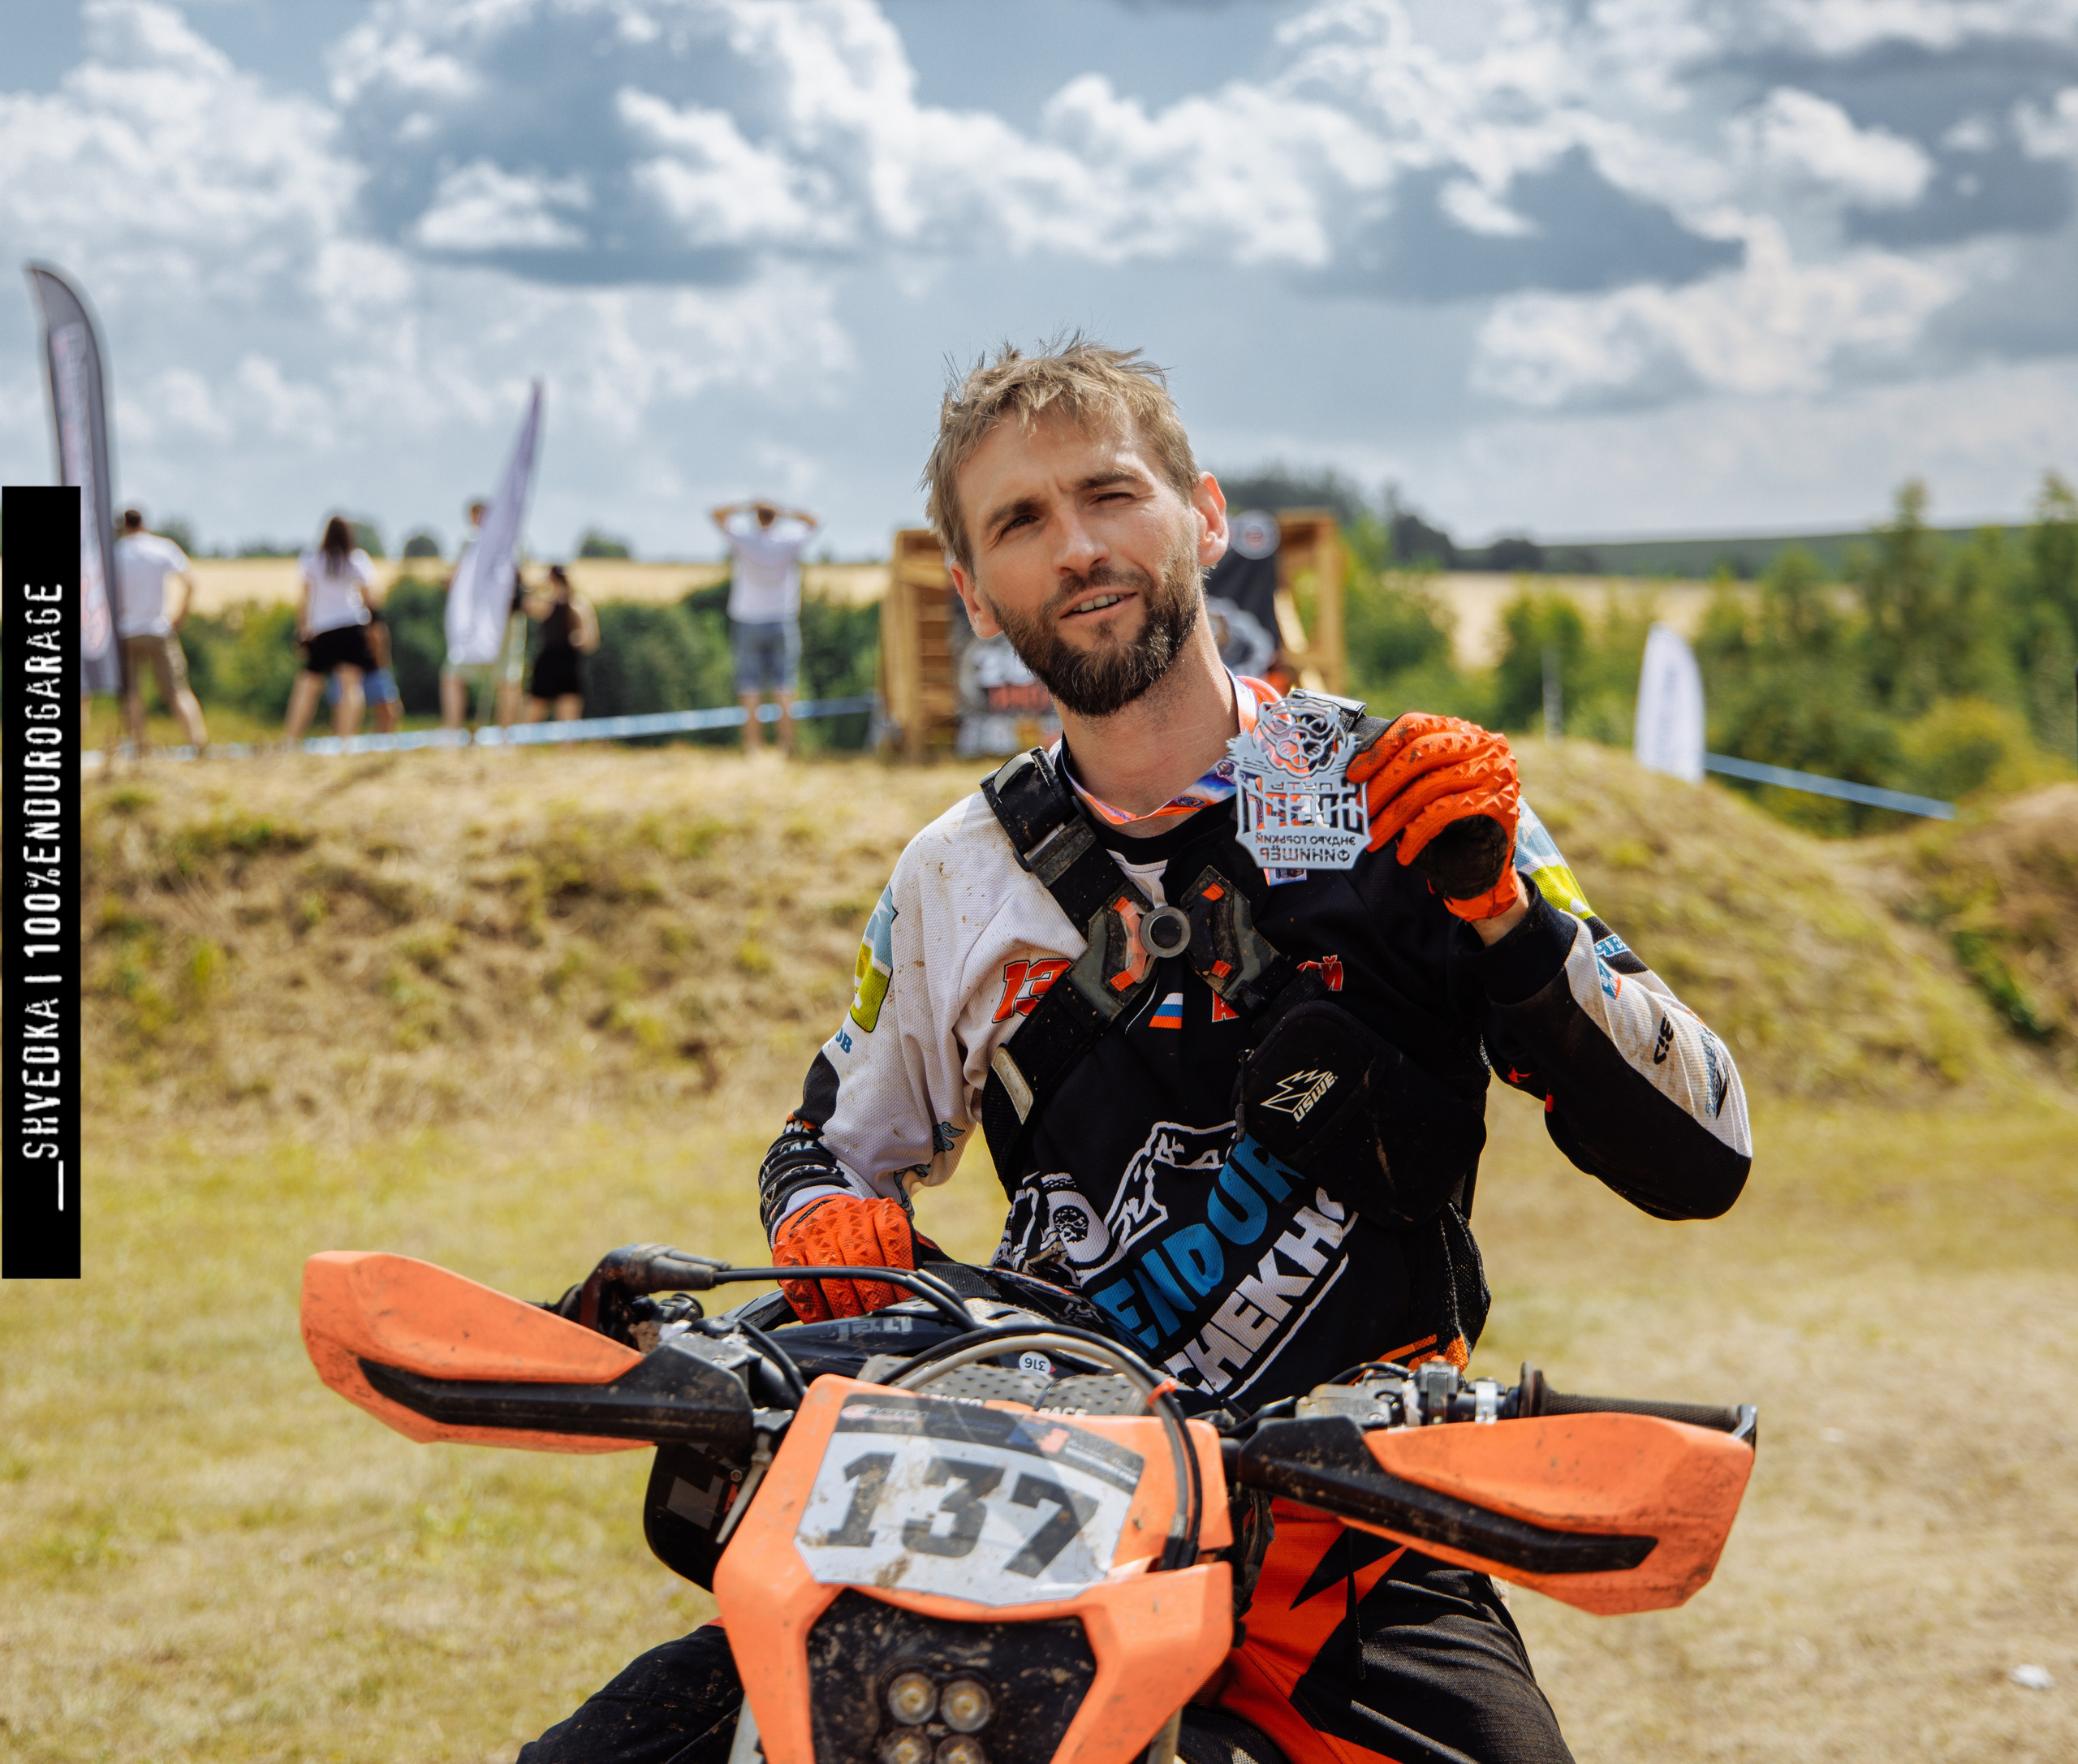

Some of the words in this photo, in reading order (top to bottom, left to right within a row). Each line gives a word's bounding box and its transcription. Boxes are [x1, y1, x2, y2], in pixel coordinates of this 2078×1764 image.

[1293, 1071, 1336, 1123] USWE
[1090, 1135, 1305, 1351] ENDUR
[1024, 1357, 1046, 1372] 316
[826, 1451, 1099, 1579] 137
